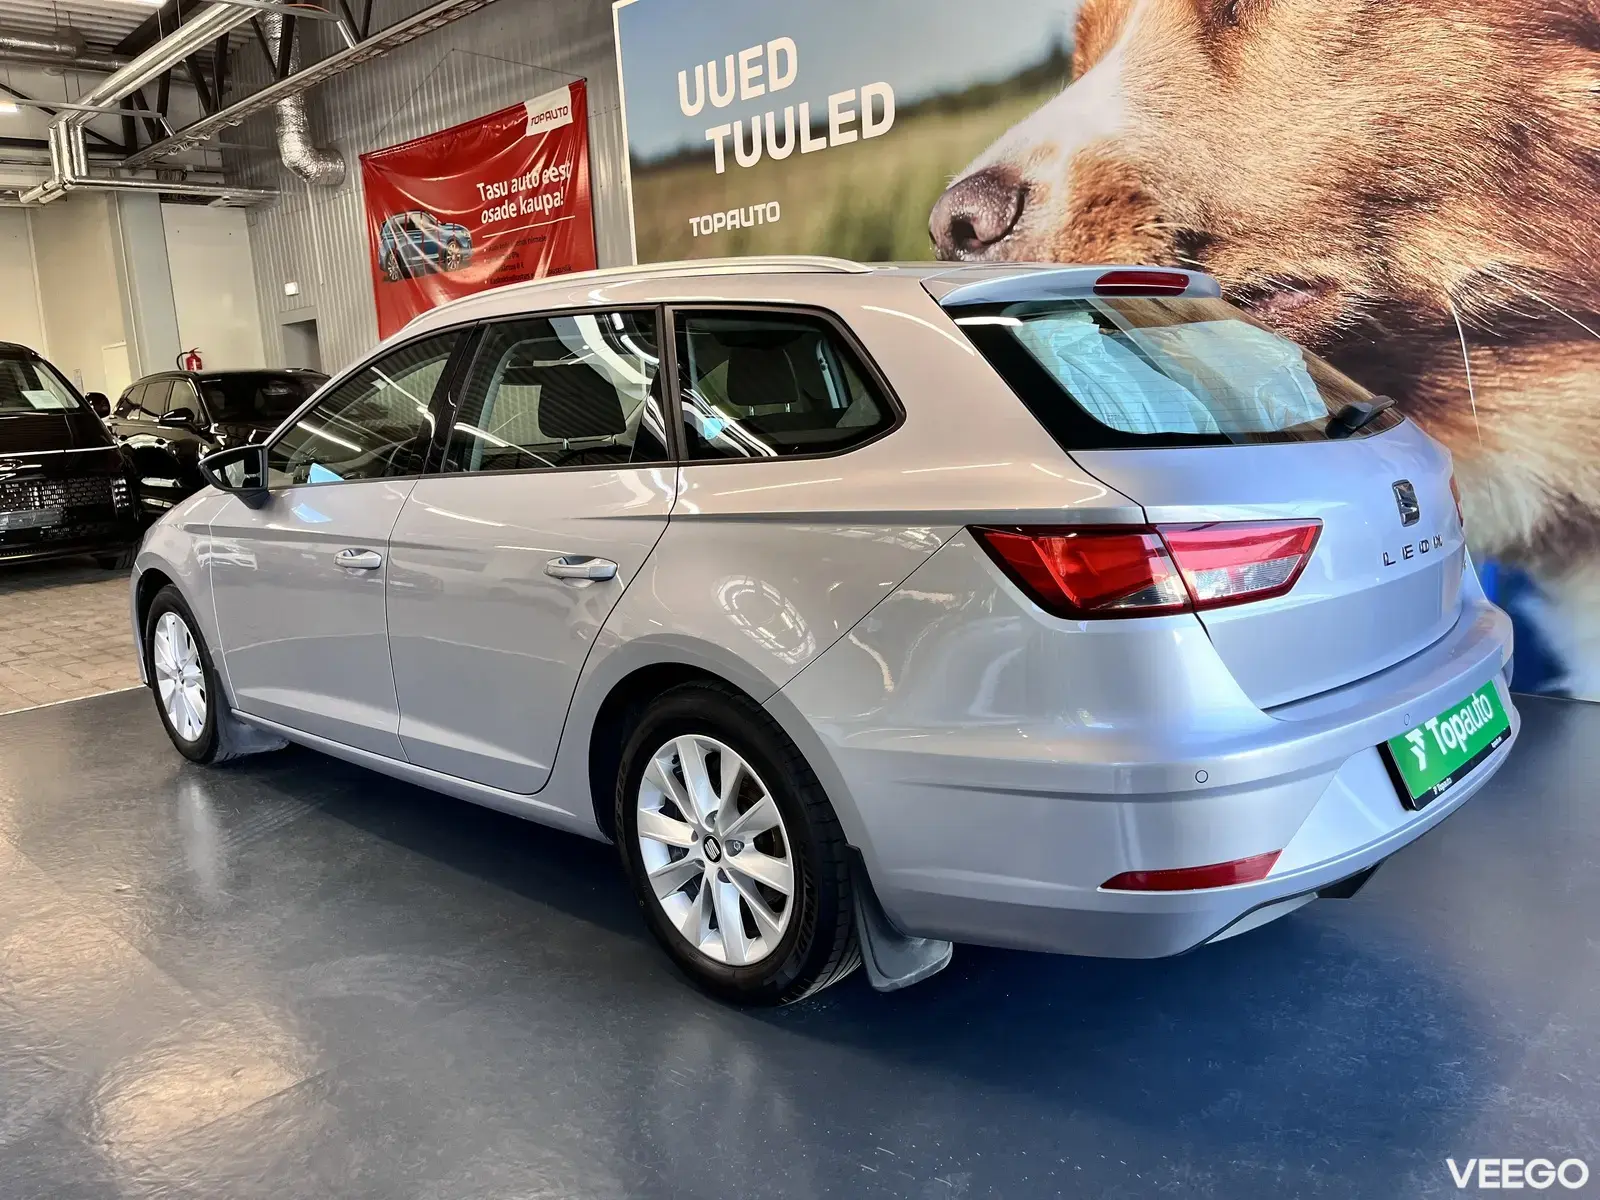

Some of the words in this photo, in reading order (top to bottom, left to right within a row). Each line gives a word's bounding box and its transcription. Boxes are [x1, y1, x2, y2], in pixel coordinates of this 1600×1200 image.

[678, 36, 798, 117] UUED
[530, 105, 569, 127] TOPAUTO
[705, 81, 896, 175] TUULED
[476, 182, 508, 202] Tasu
[511, 171, 540, 194] auto
[542, 162, 571, 185] eest
[481, 199, 518, 224] osade
[519, 186, 564, 216] kaupa!
[688, 200, 781, 238] TOPAUTO
[1425, 692, 1494, 756] Topauto
